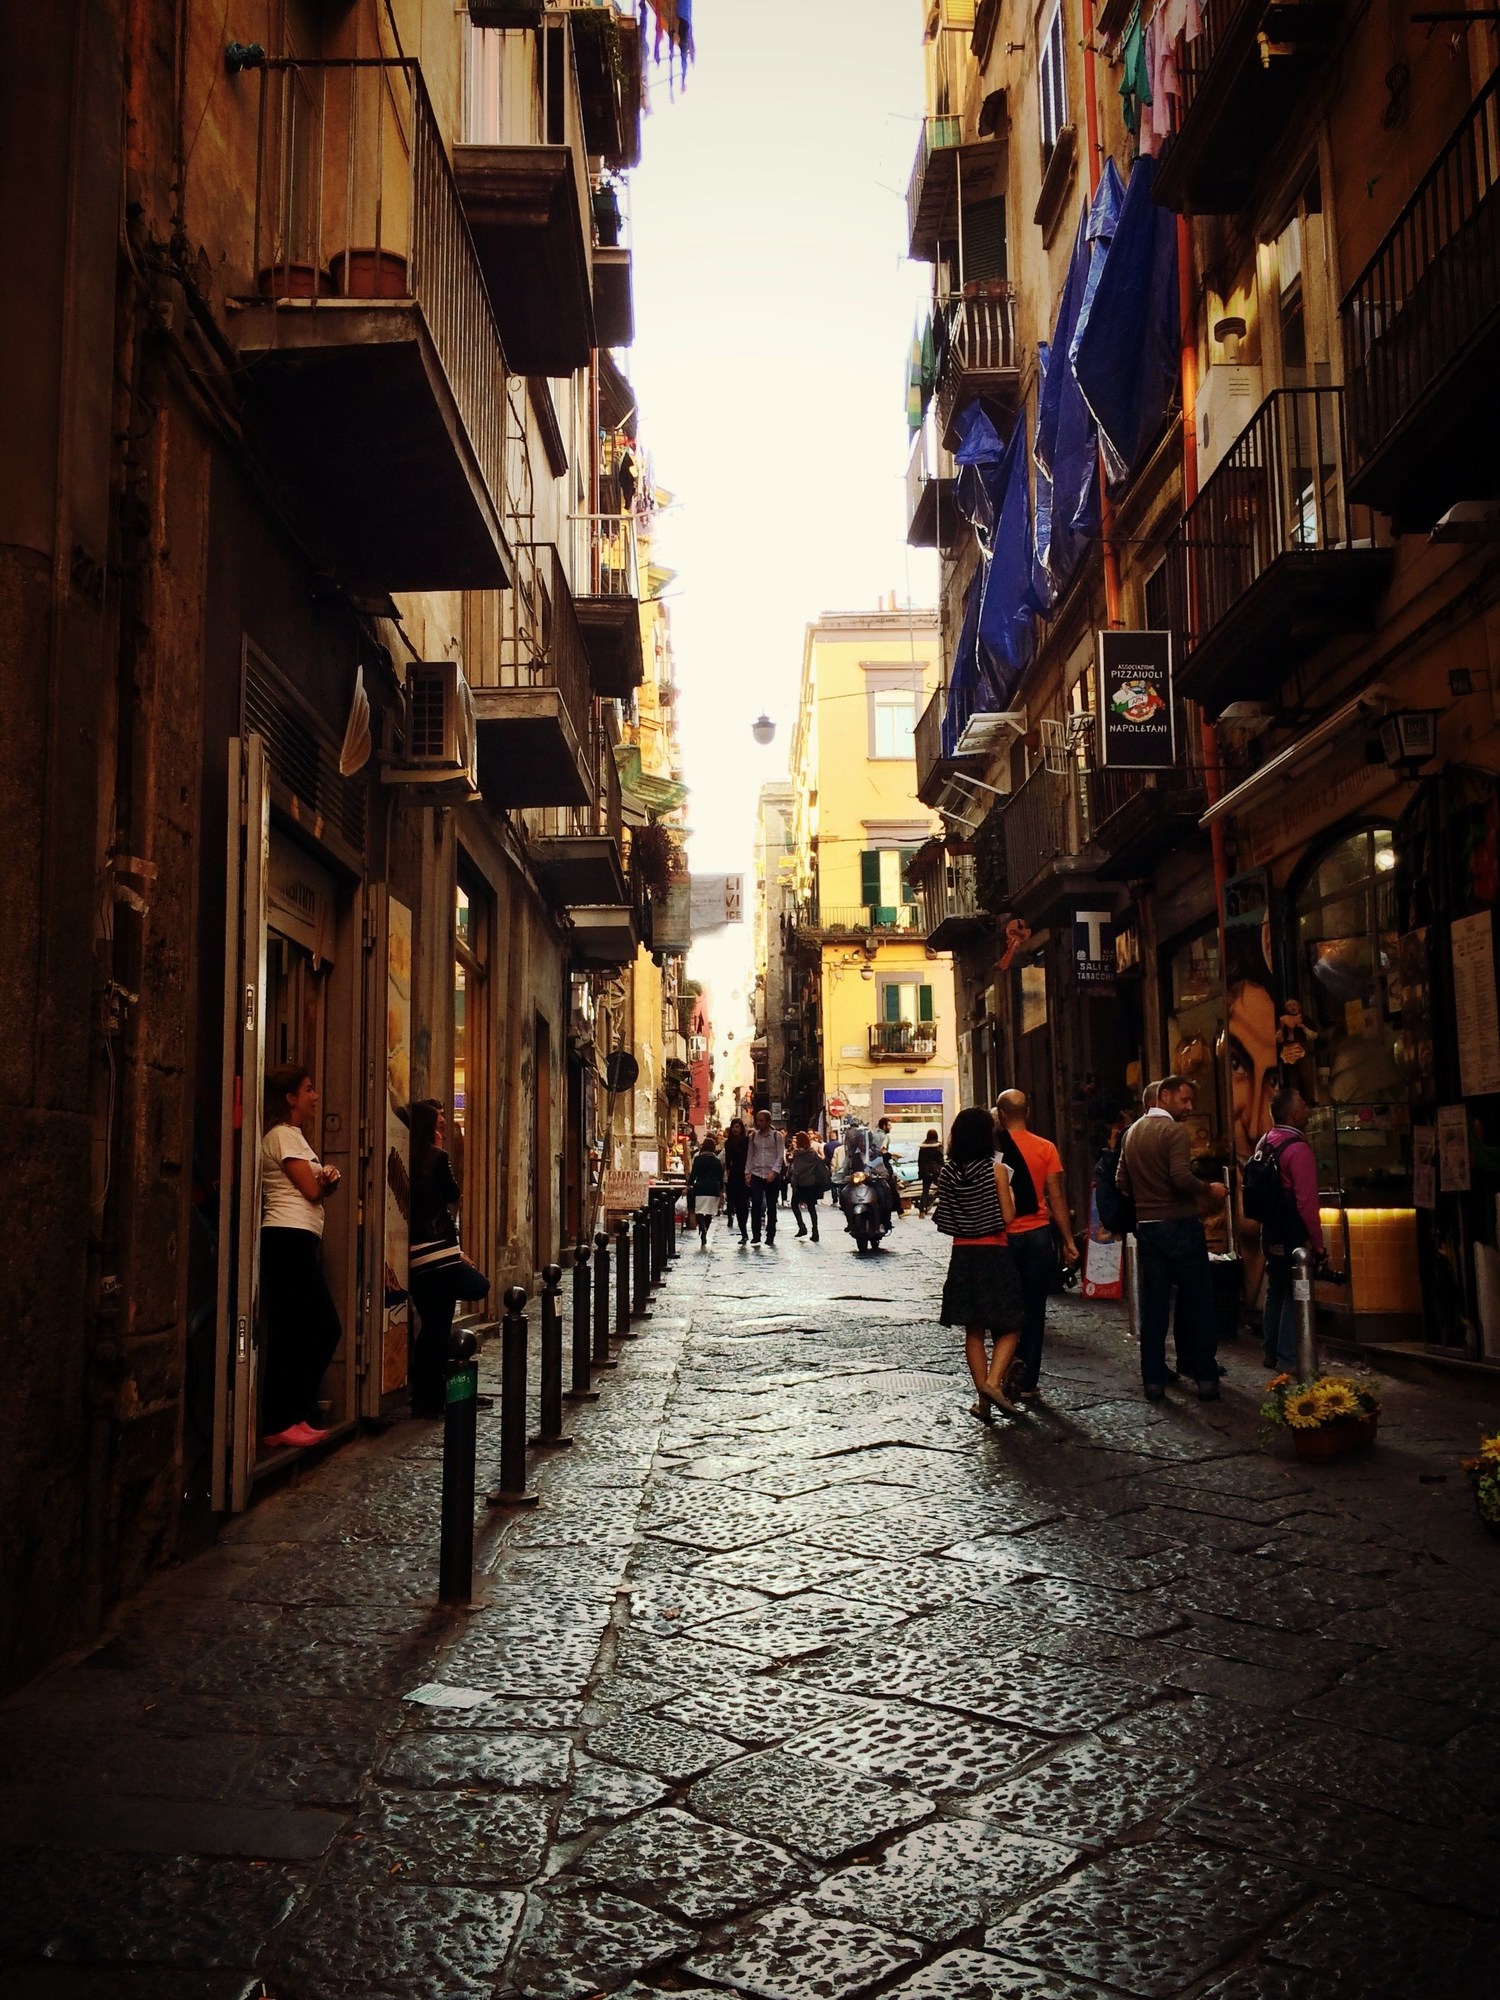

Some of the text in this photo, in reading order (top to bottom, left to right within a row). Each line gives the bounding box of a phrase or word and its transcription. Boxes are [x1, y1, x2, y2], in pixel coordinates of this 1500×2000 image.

[1111, 670, 1163, 679] PIZZAIUOLI
[1110, 724, 1167, 733] NAPOLETANI
[726, 877, 740, 890] LI
[725, 894, 740, 908] VI
[726, 911, 741, 920] ICE
[1076, 911, 1111, 961] T
[1080, 963, 1101, 971] SALI
[1077, 972, 1114, 981] TABACCHI
